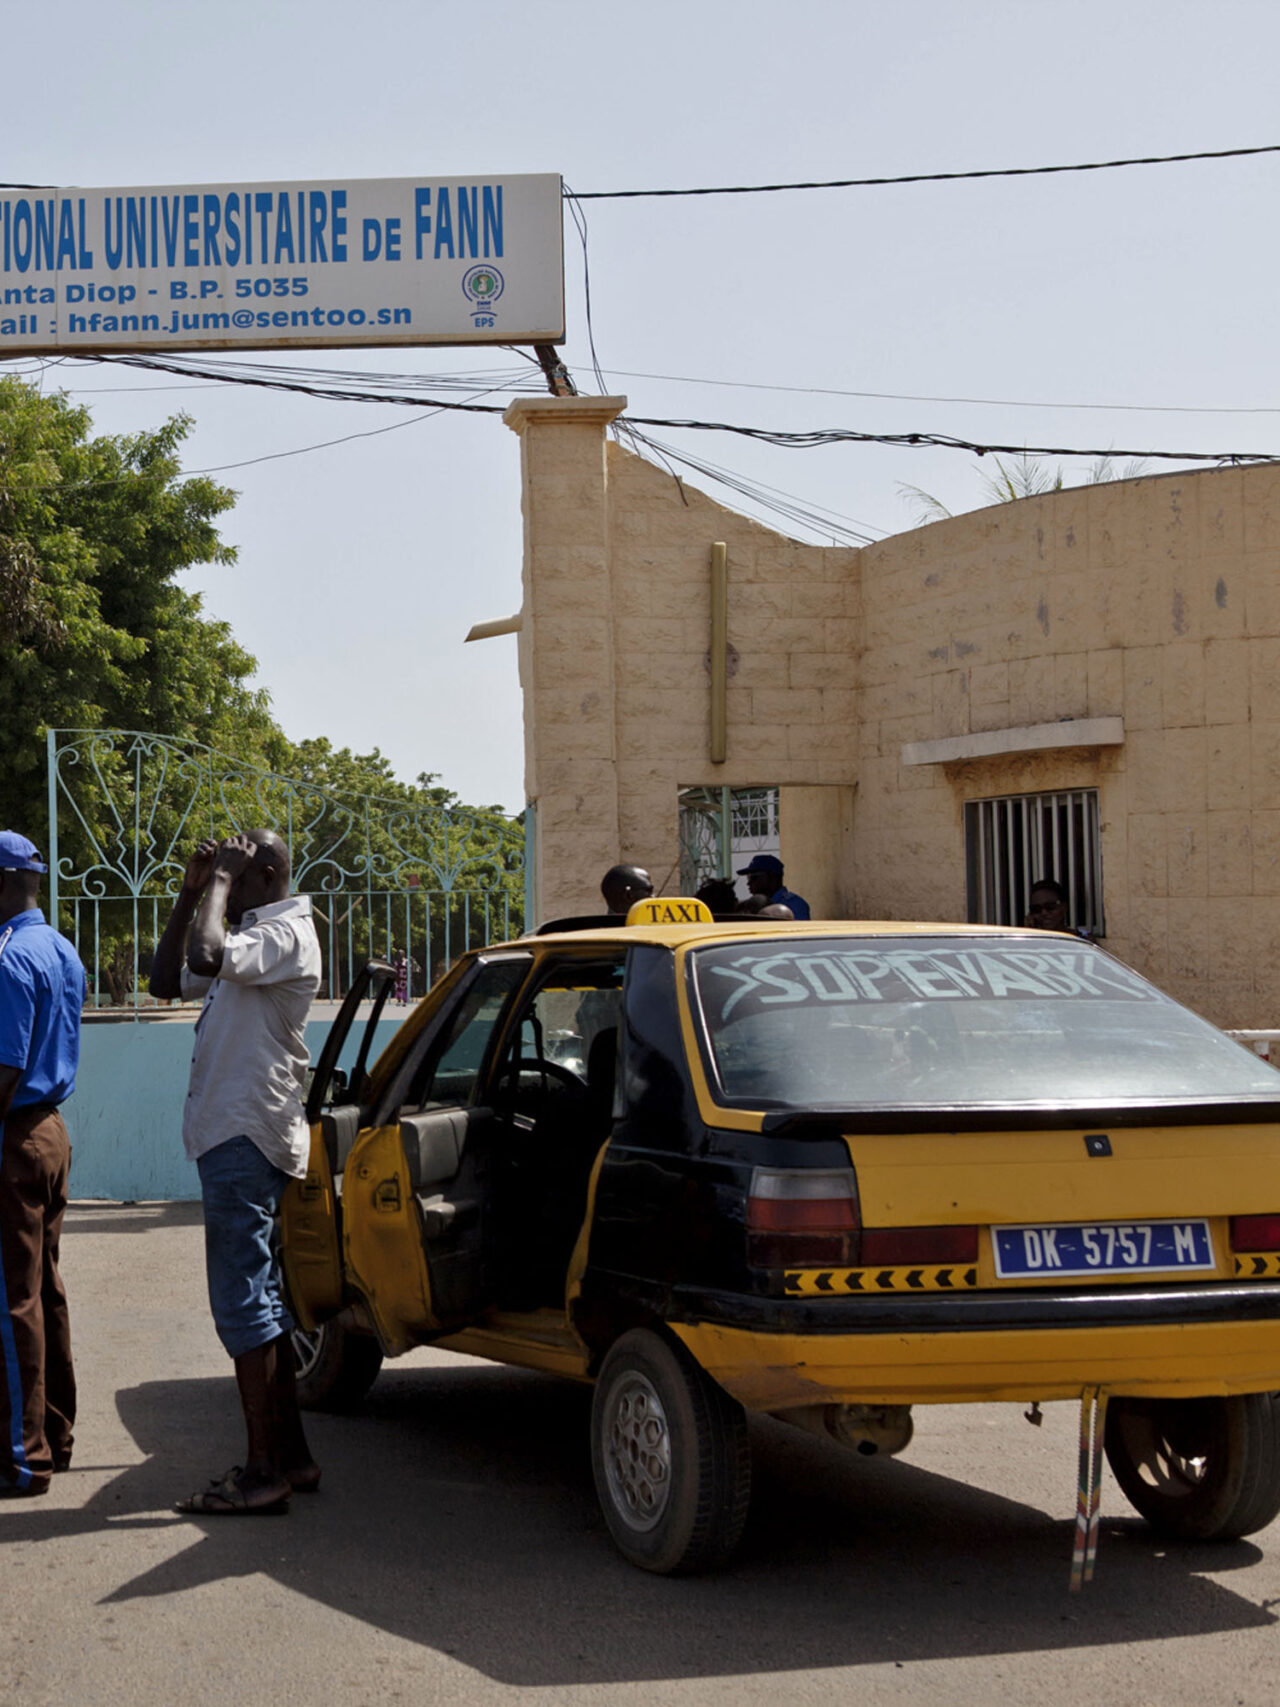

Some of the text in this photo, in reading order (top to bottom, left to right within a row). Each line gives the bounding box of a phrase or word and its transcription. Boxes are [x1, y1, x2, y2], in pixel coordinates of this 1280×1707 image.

[104, 189, 348, 271] UNIVERSITAIRE
[362, 217, 401, 262] DE
[414, 185, 504, 260] FANN
[65, 282, 137, 305] Diop
[169, 279, 224, 301] B.P.
[234, 276, 310, 299] 5035
[68, 306, 412, 334] hfann.jum@sentoo.sn
[474, 317, 494, 328] EPS
[646, 904, 702, 923] TAXI
